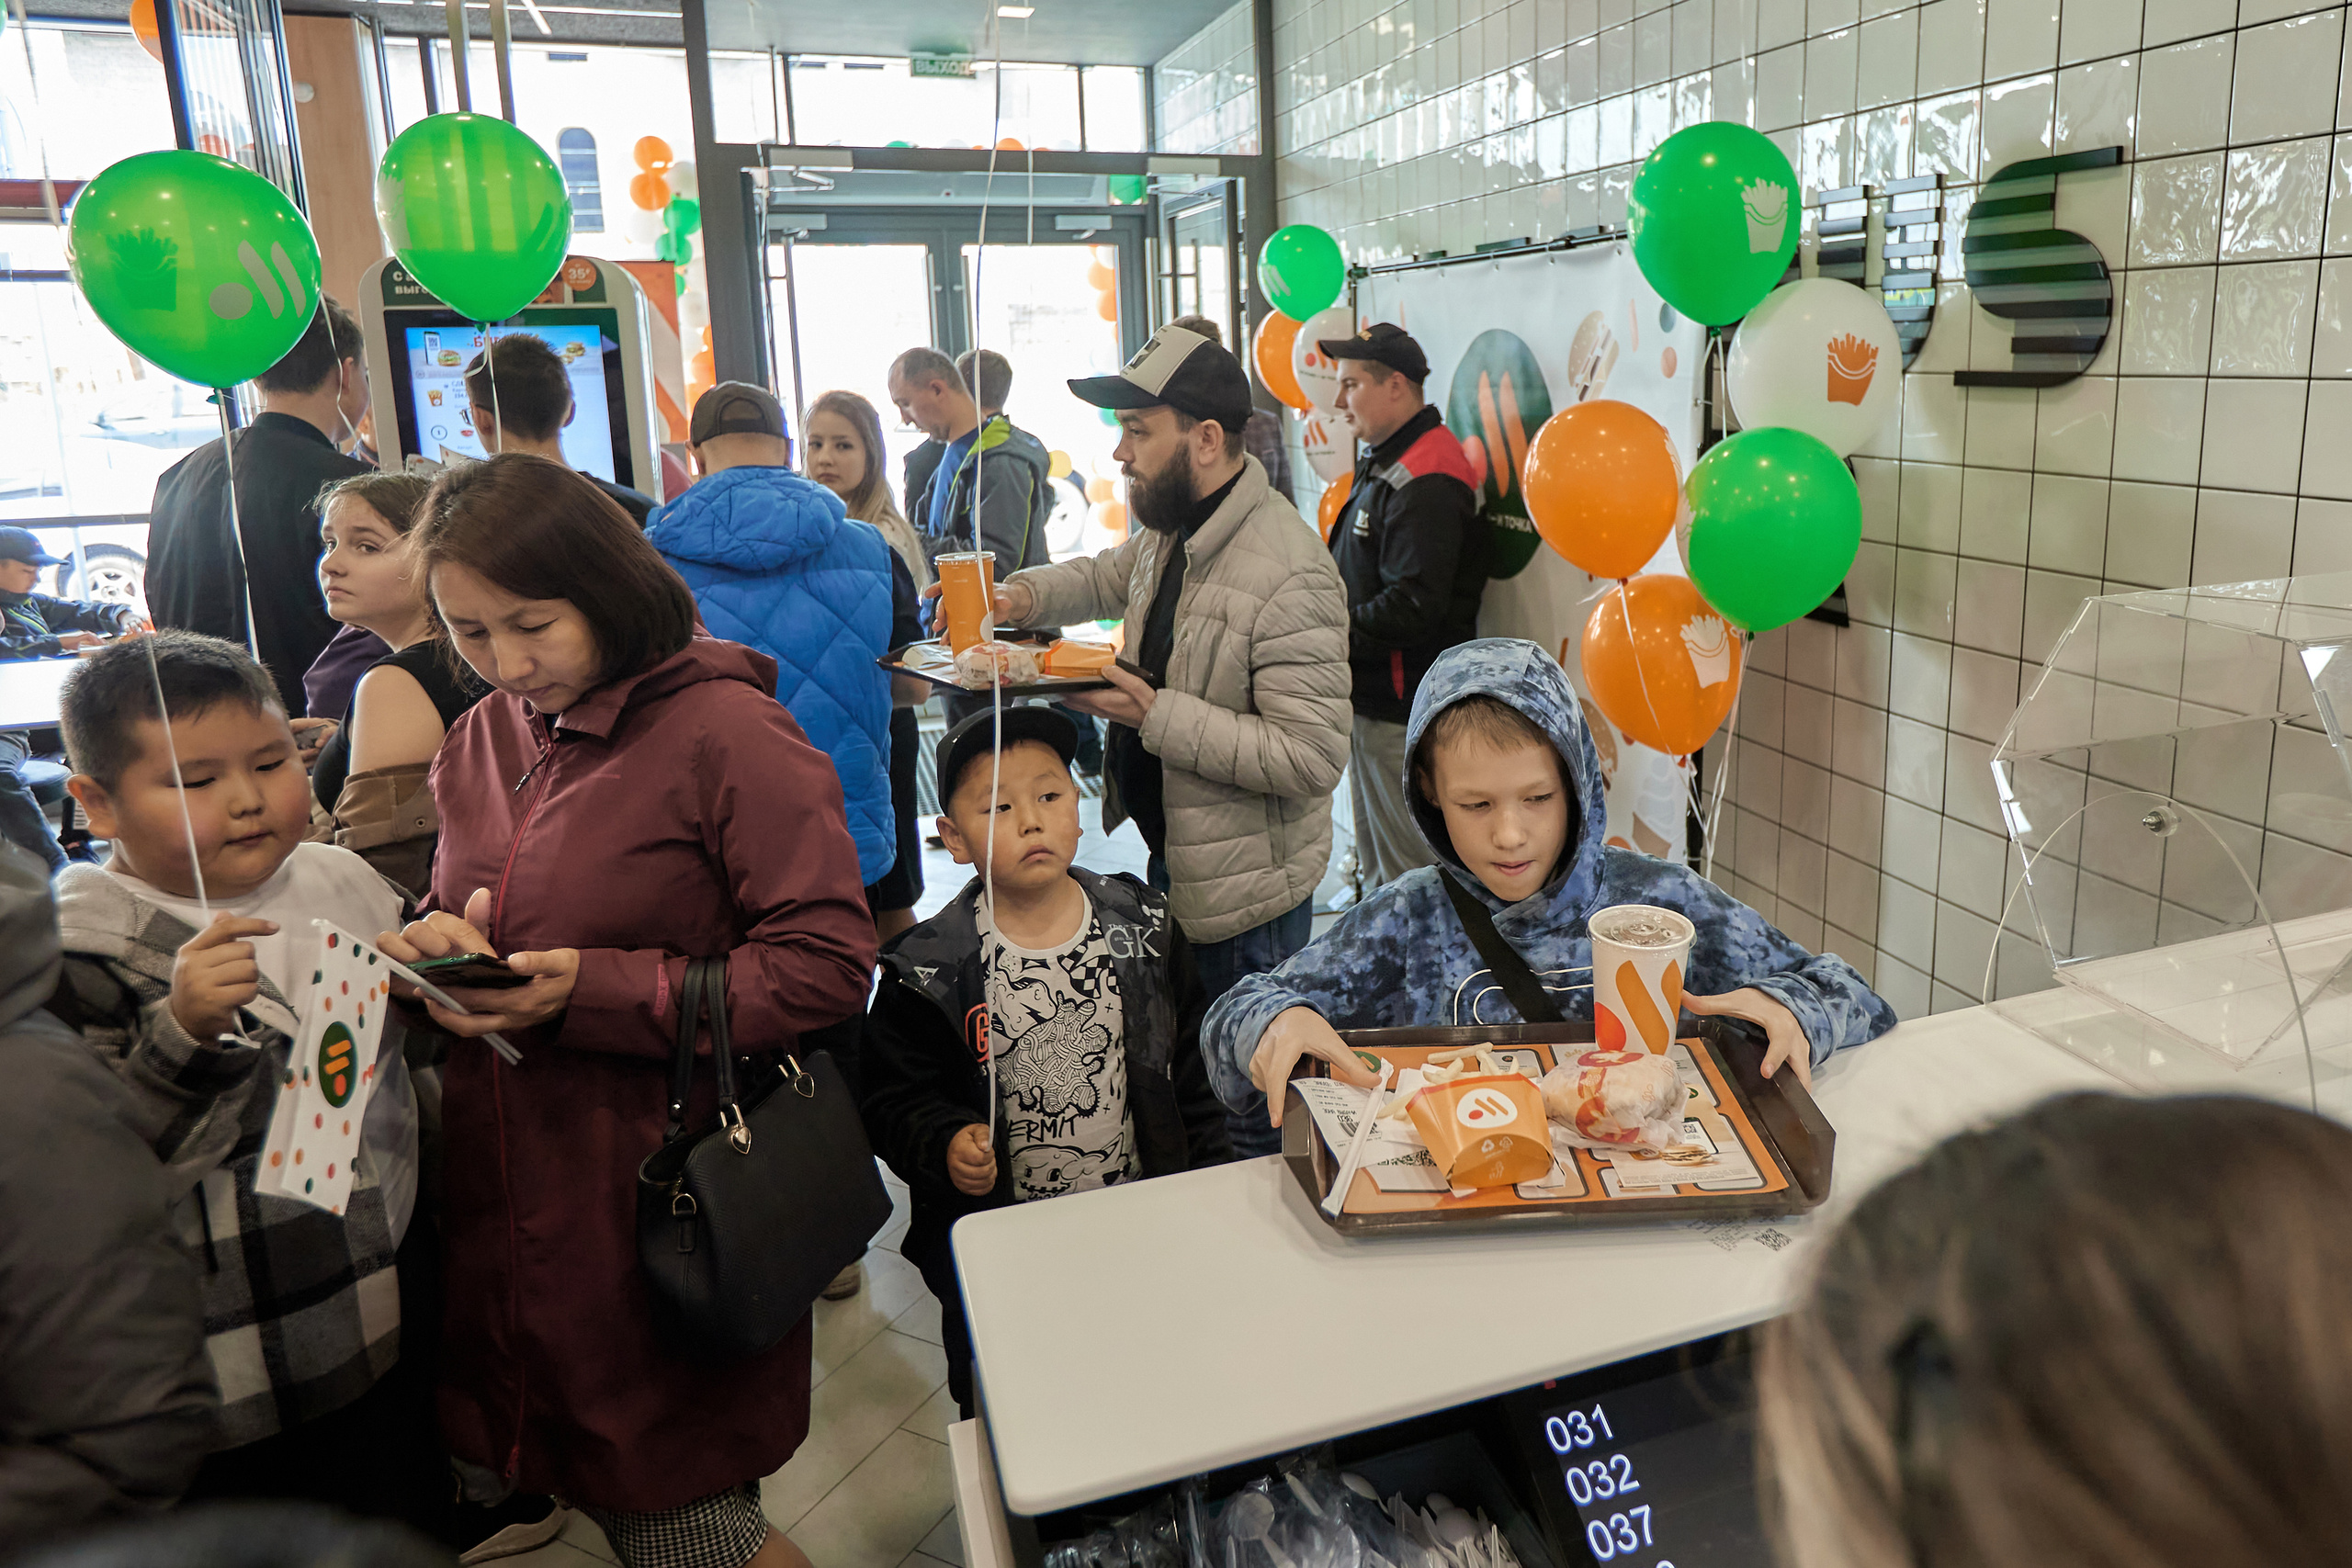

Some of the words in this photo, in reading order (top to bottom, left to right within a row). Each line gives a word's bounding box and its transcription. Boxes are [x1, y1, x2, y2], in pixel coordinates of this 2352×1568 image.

[915, 60, 971, 75] ВЫХОД
[1505, 515, 1533, 534] ТОЧКА
[1104, 925, 1161, 959] GK
[1545, 1403, 1614, 1455] 031
[1565, 1453, 1641, 1506] 032
[1586, 1504, 1653, 1562] 037
